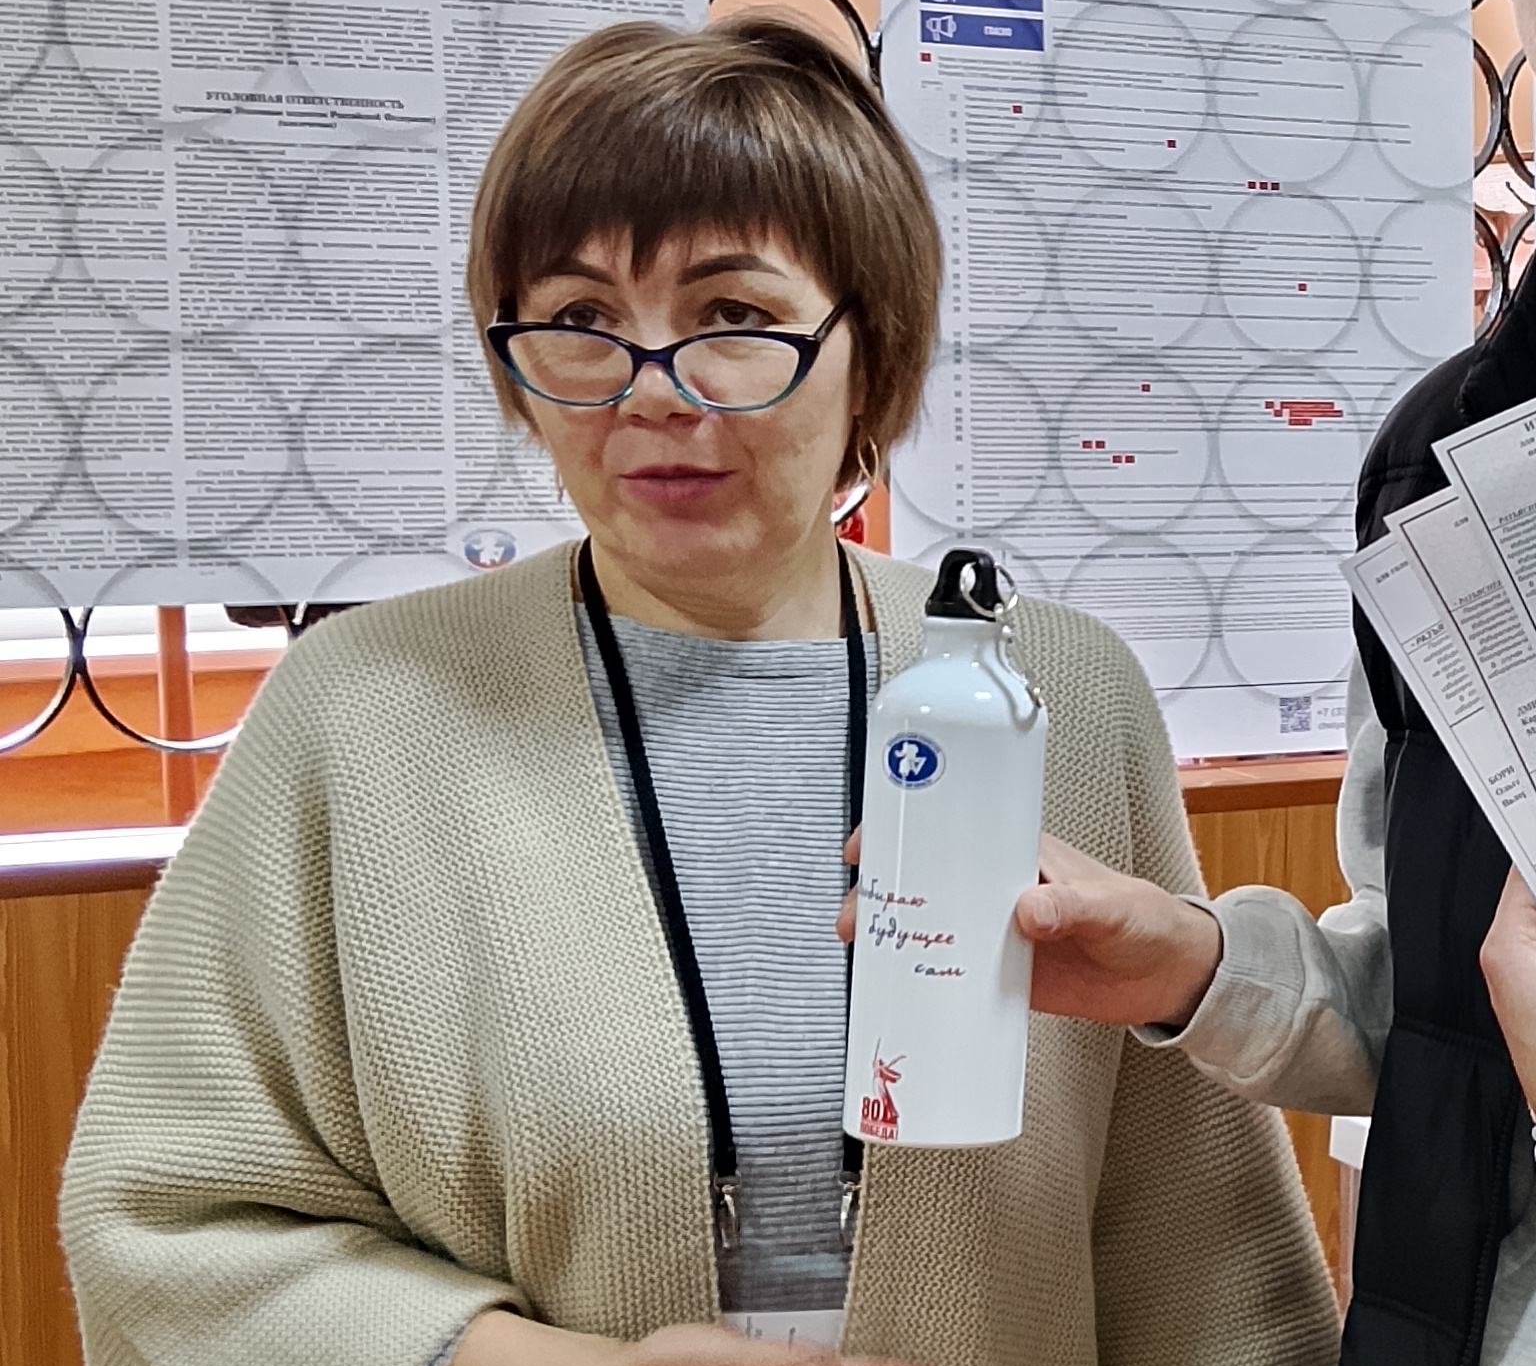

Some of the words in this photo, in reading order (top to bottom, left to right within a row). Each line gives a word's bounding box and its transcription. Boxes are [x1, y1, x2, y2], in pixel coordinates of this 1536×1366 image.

[869, 913, 954, 949] будущее
[915, 964, 966, 976] сам
[862, 1096, 880, 1121] 80
